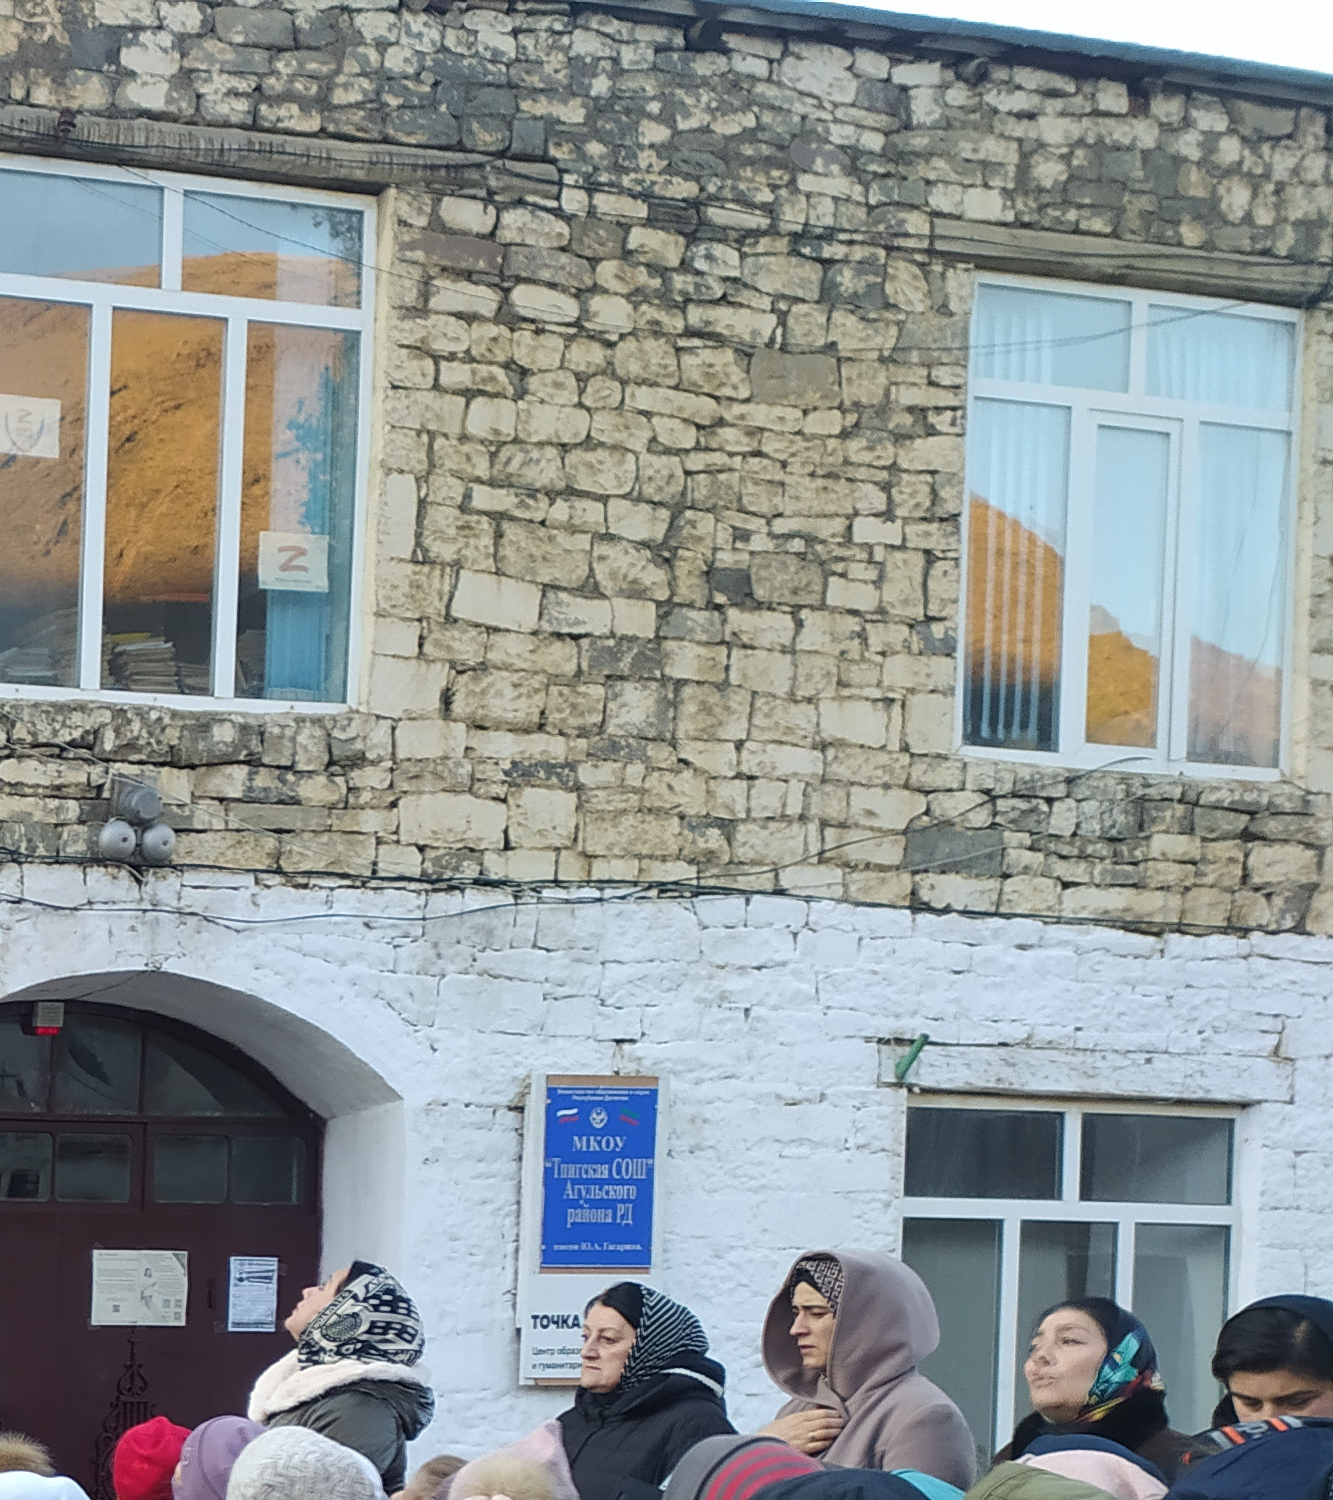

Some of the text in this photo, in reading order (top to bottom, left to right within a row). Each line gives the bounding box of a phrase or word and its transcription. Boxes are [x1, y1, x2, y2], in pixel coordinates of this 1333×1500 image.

[572, 1135, 627, 1152] МКОУ
[563, 1180, 637, 1205] Агульского
[567, 1203, 633, 1228] района РД
[531, 1314, 581, 1329] ТОЧКА
